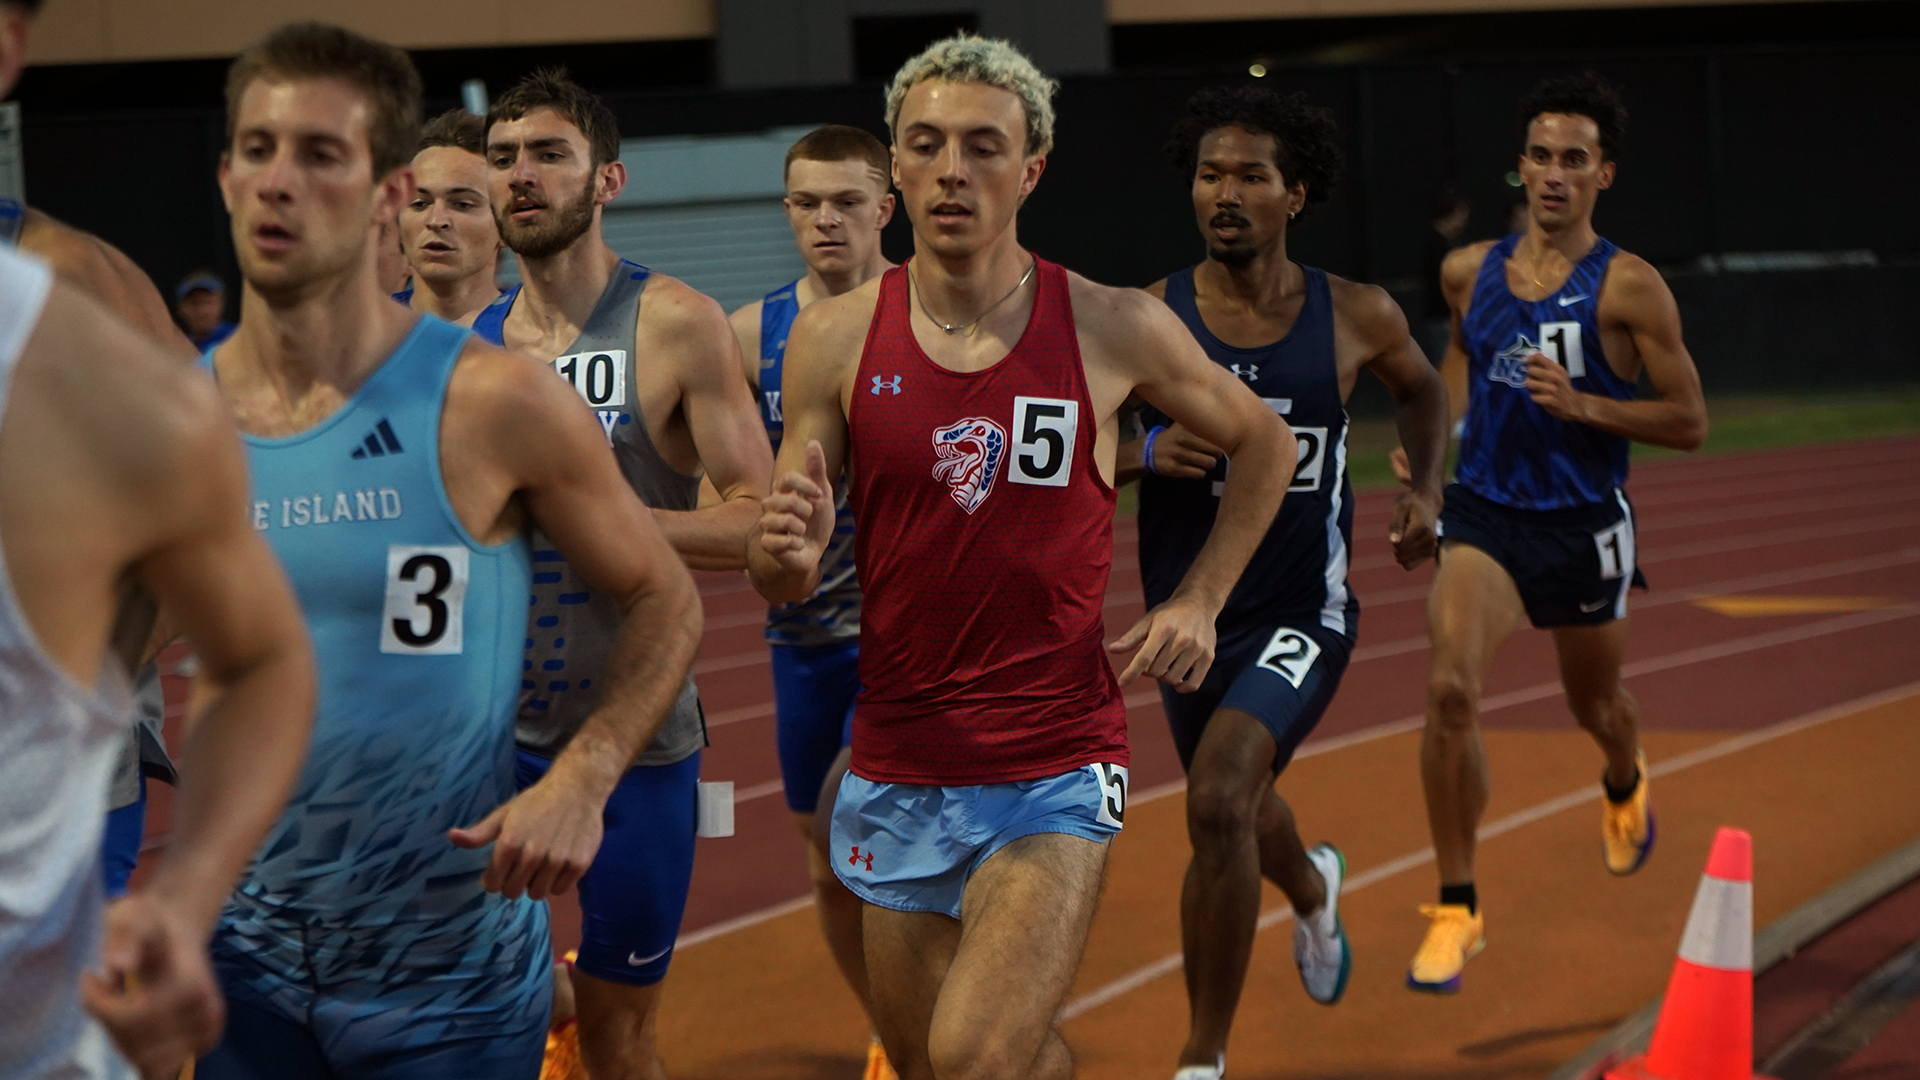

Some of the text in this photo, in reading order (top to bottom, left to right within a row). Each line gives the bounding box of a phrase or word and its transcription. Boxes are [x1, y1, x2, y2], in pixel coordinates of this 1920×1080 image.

[1547, 328, 1567, 371] 1
[561, 353, 614, 405] 10
[1018, 403, 1066, 479] 5
[1290, 432, 1319, 487] 2
[281, 489, 402, 528] ISLAND
[1603, 533, 1621, 571] 1
[392, 554, 453, 648] 3
[1265, 634, 1309, 680] 2
[1100, 763, 1125, 823] 5
